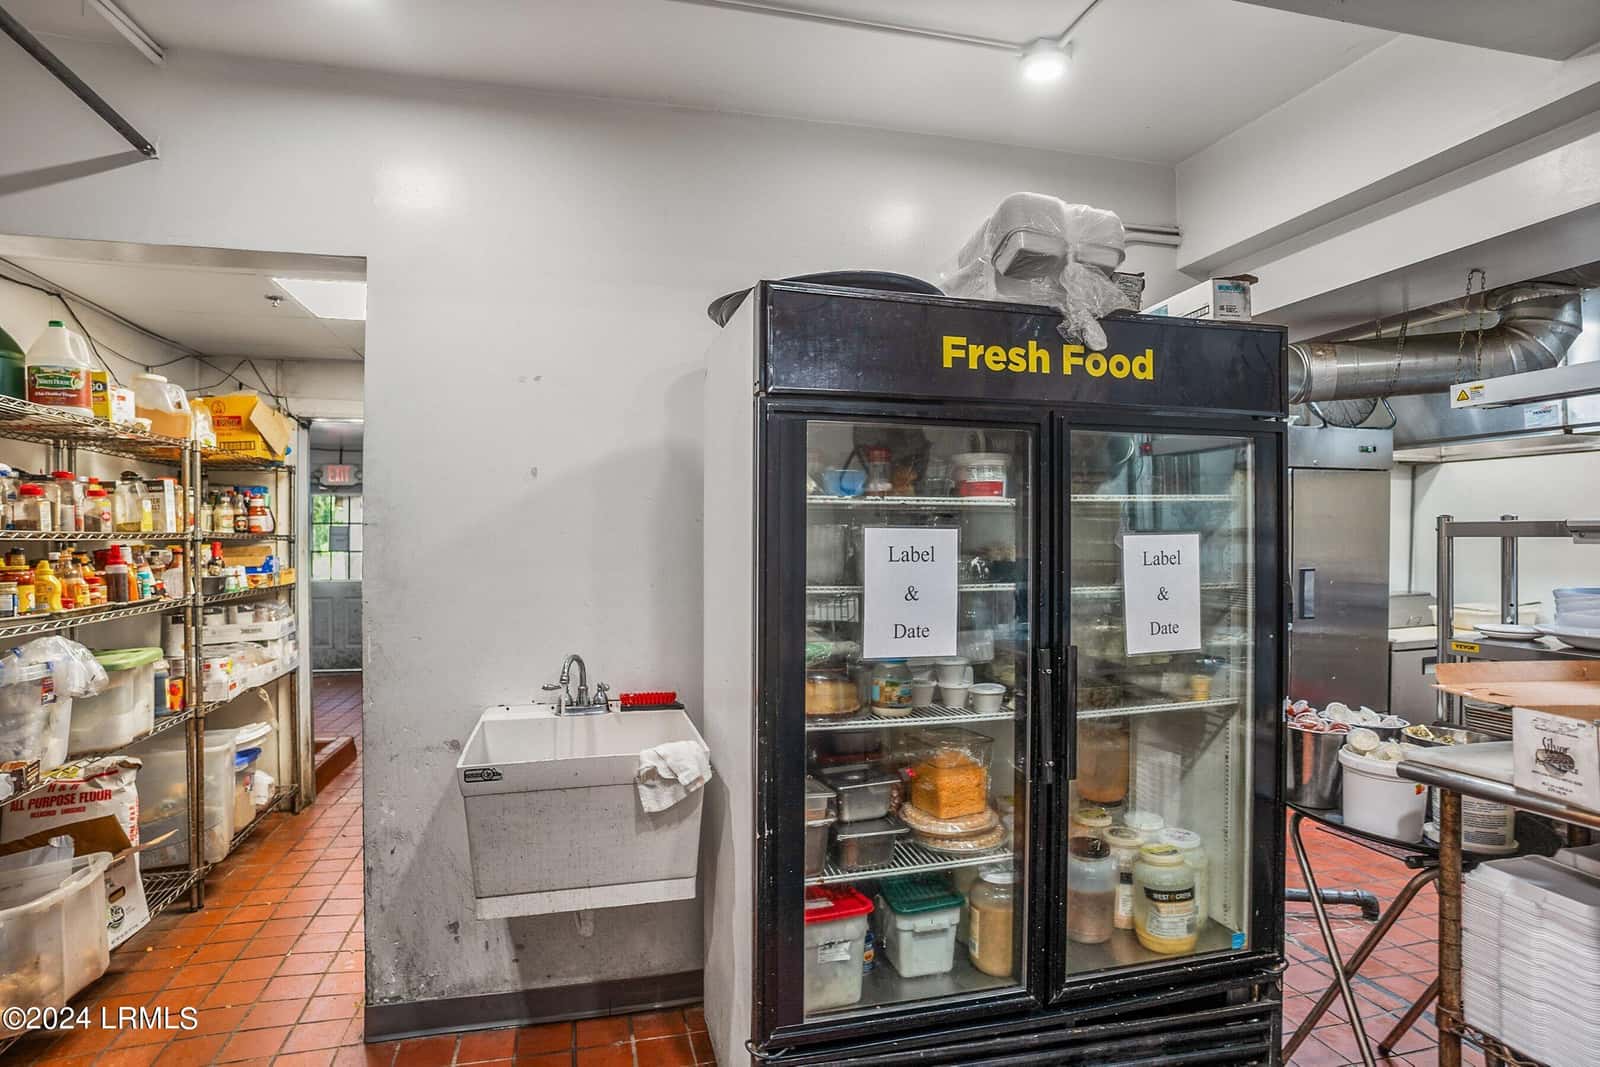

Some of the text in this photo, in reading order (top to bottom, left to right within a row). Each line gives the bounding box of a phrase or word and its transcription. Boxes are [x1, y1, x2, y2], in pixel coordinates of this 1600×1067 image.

[942, 335, 1154, 380] Fresh Food
[327, 464, 351, 482] EXIT
[888, 545, 935, 563] Label
[1143, 549, 1182, 566] Label
[904, 585, 920, 601] &
[1157, 586, 1169, 601] &
[894, 623, 930, 640] Date
[1150, 620, 1180, 636] Date
[9, 789, 112, 812] ALL PURPOSE FLOUR
